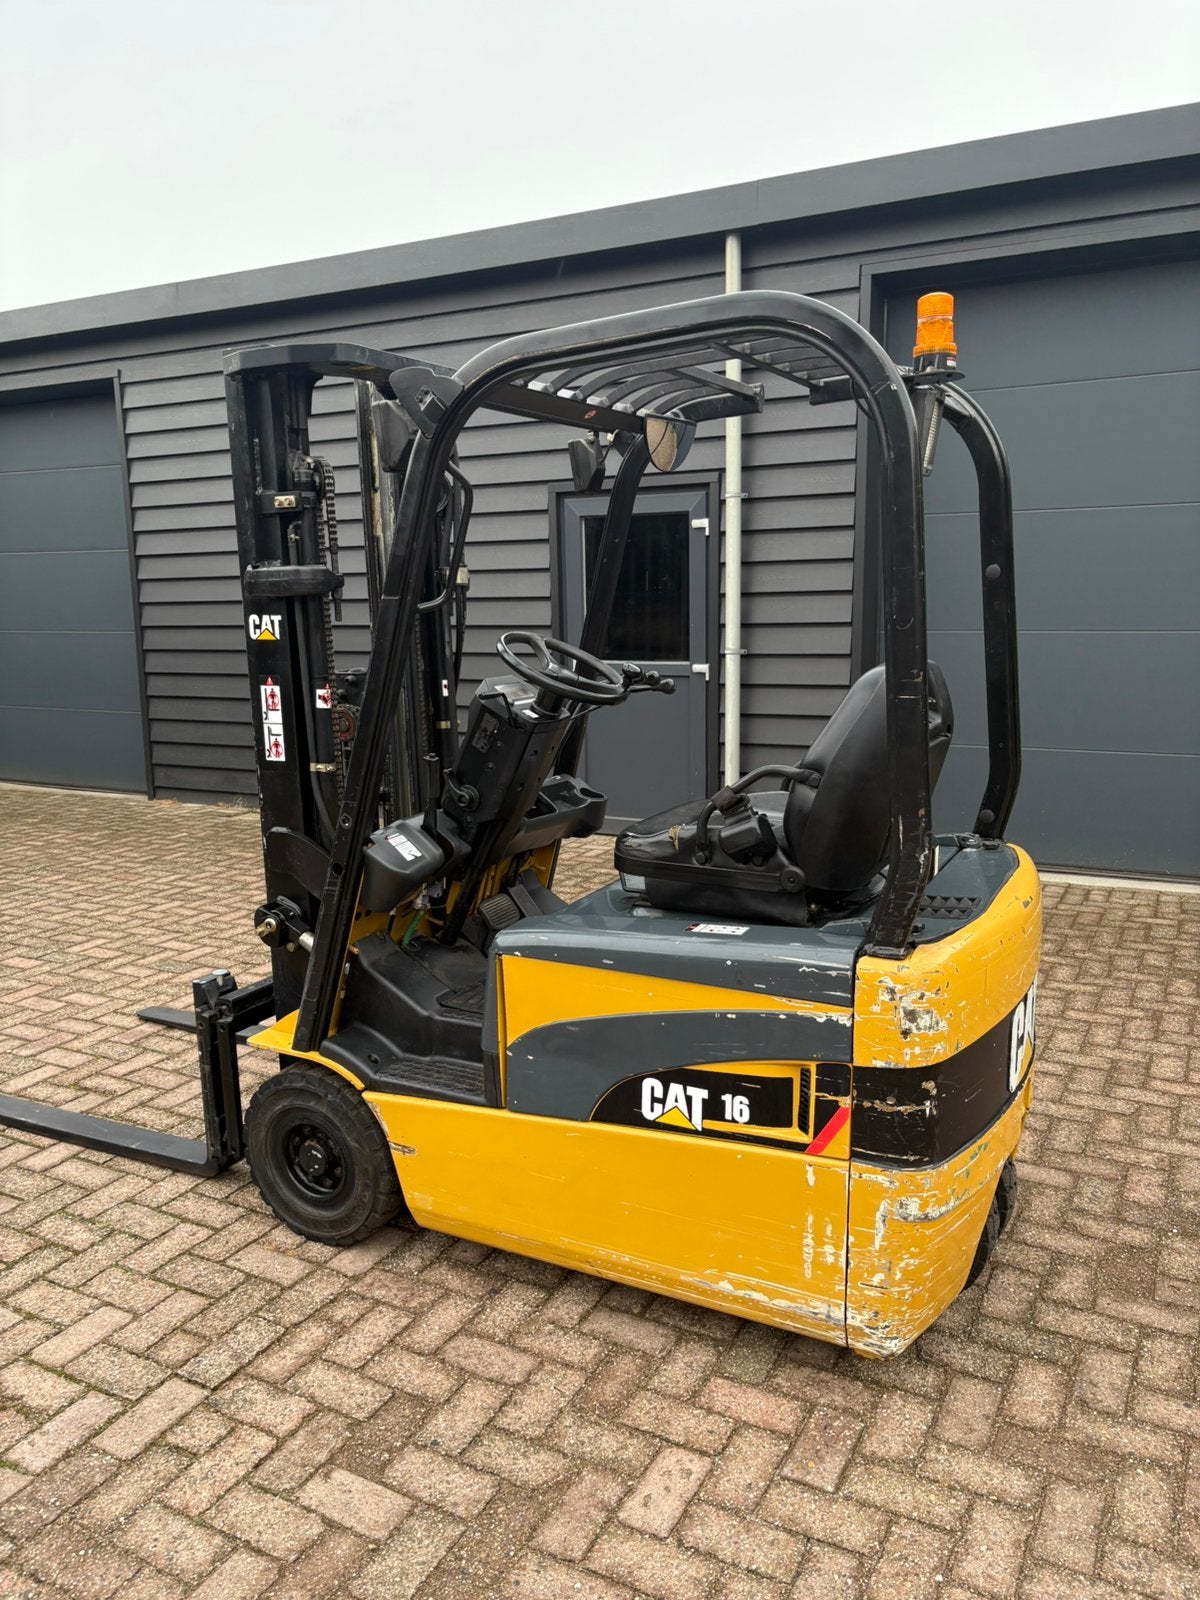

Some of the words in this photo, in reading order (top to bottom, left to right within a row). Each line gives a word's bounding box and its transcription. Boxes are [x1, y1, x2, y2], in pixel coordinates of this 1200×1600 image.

[249, 613, 282, 640] CAT
[1009, 970, 1038, 1093] CA
[641, 1078, 708, 1132] CAT
[721, 1093, 750, 1124] 16
